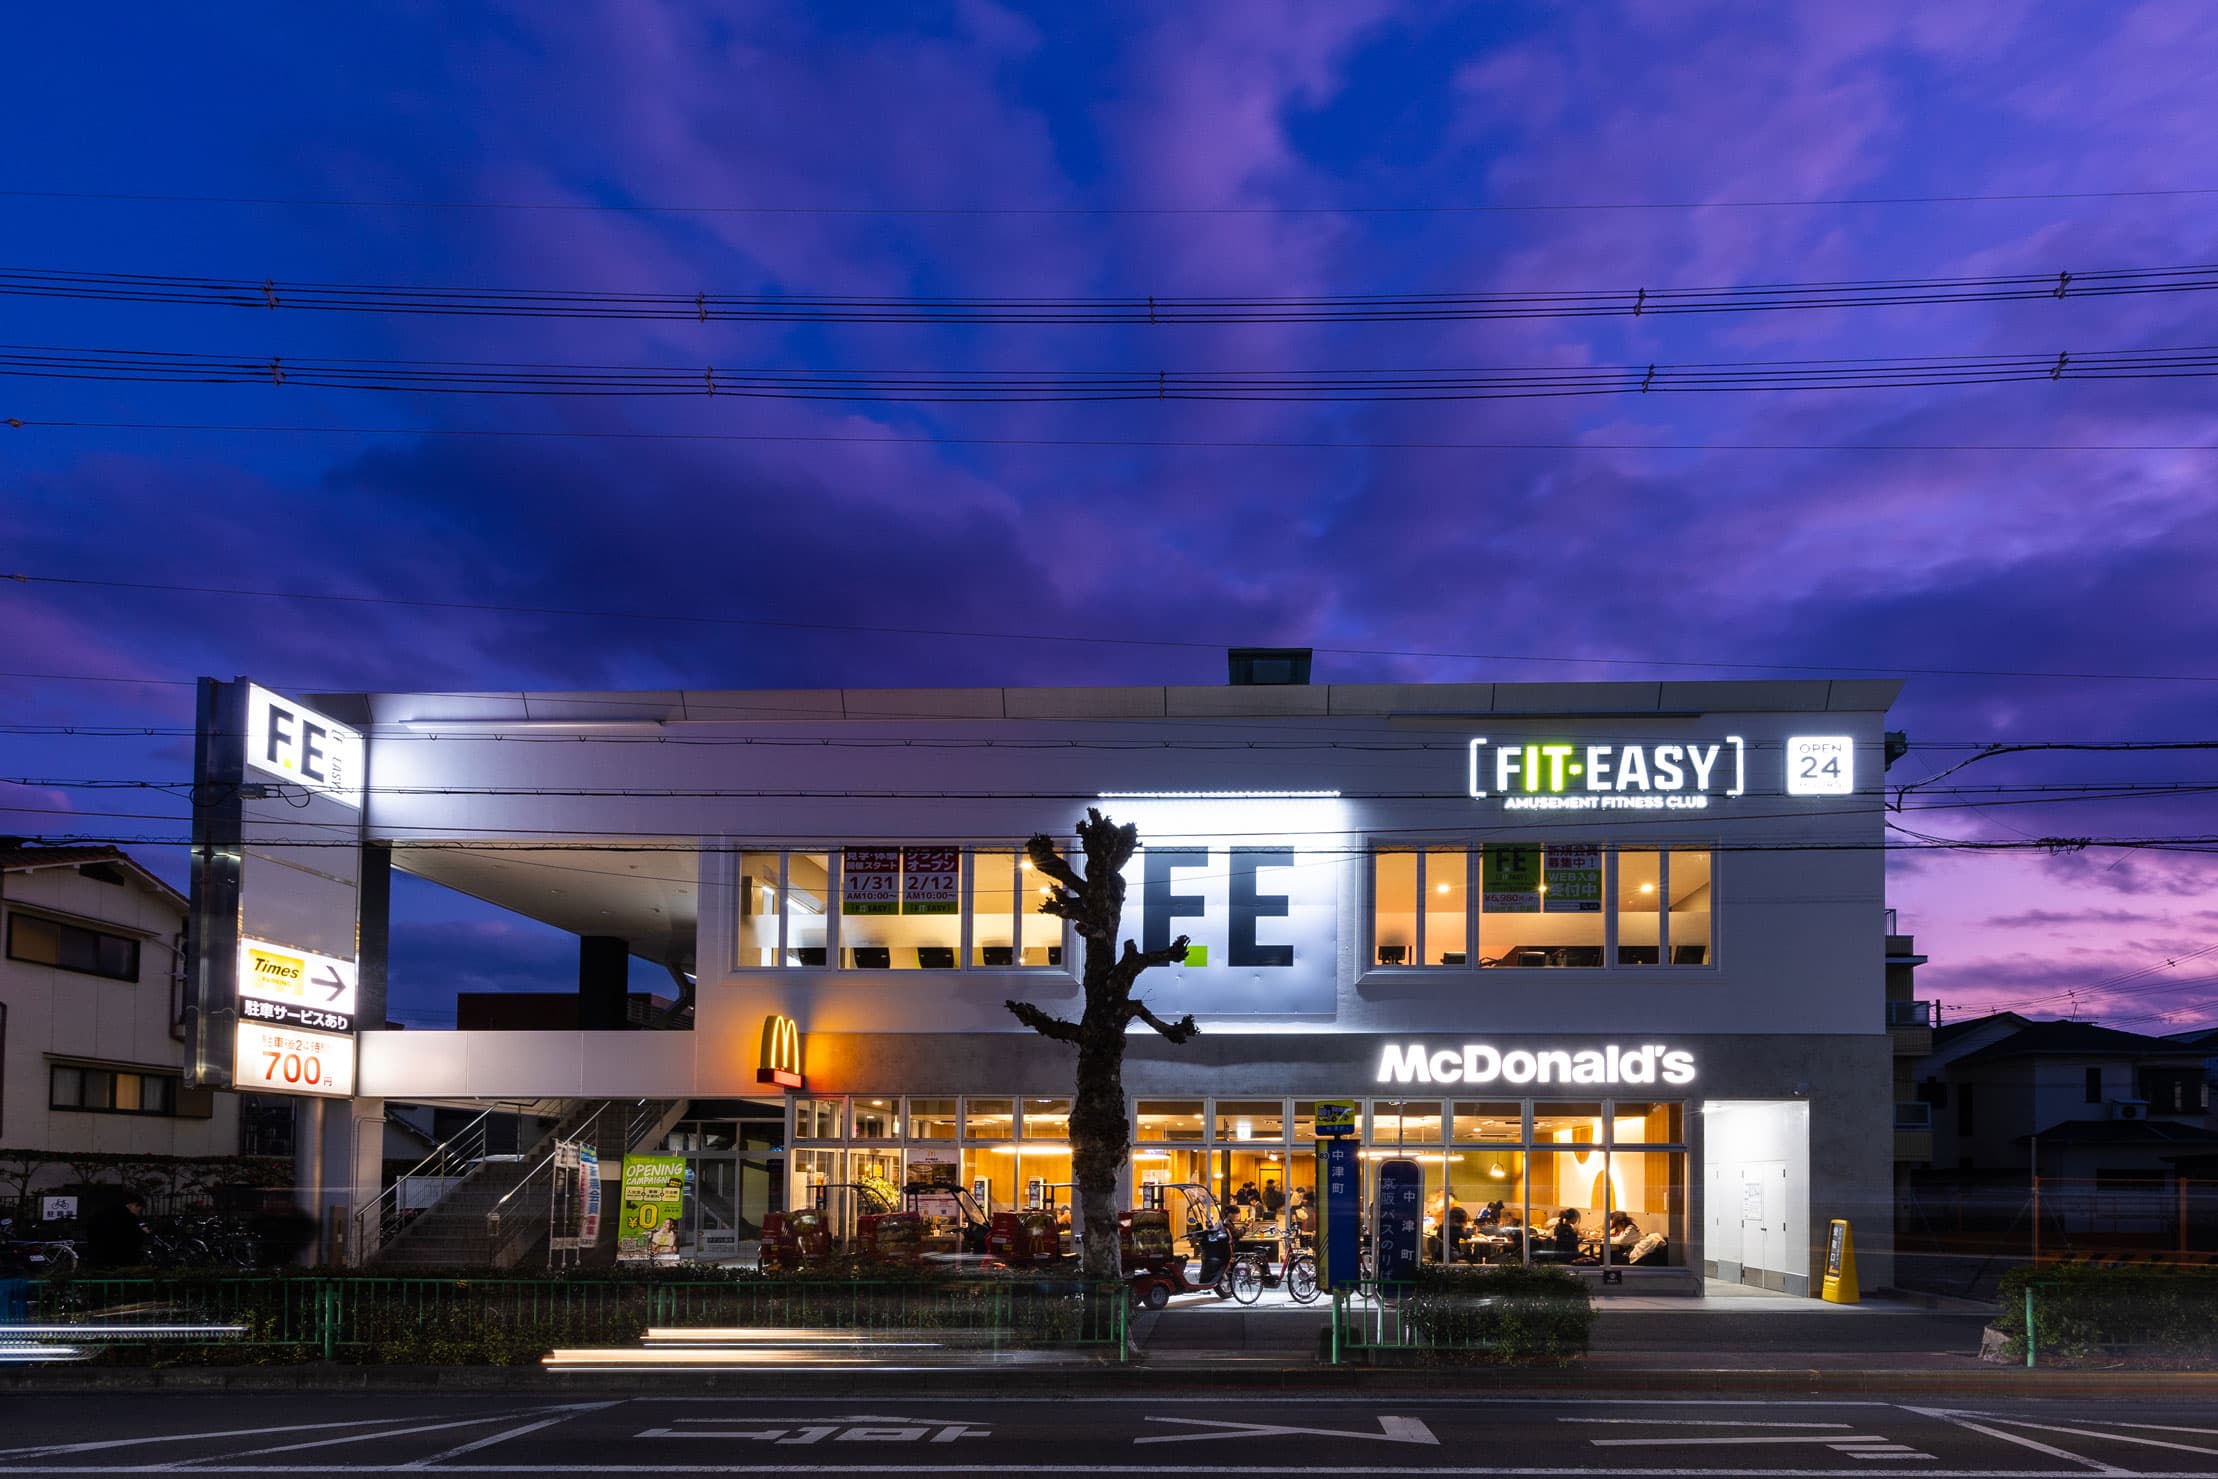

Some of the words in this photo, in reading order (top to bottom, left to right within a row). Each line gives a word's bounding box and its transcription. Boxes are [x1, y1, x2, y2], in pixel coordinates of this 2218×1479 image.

[1800, 743, 1842, 754] OPEN
[1800, 756, 1842, 779] 24
[1504, 797, 1601, 810] AMUSEMENT
[1601, 797, 1664, 810] FITNESS
[1666, 797, 1707, 810] CLUB
[907, 860, 955, 872] オープン
[849, 876, 893, 891] 1/31
[908, 876, 954, 891] 2/12
[1549, 883, 1597, 897] 受付中
[254, 957, 300, 979] Times
[244, 999, 348, 1031] 駐車サービスあり
[1377, 1044, 1696, 1084] McDonald's
[626, 1163, 683, 1177] OPENING
[1331, 1148, 1345, 1195] 中津町
[1380, 1177, 1397, 1281] 京阪バスのりば
[1400, 1190, 1417, 1261] 中津町
